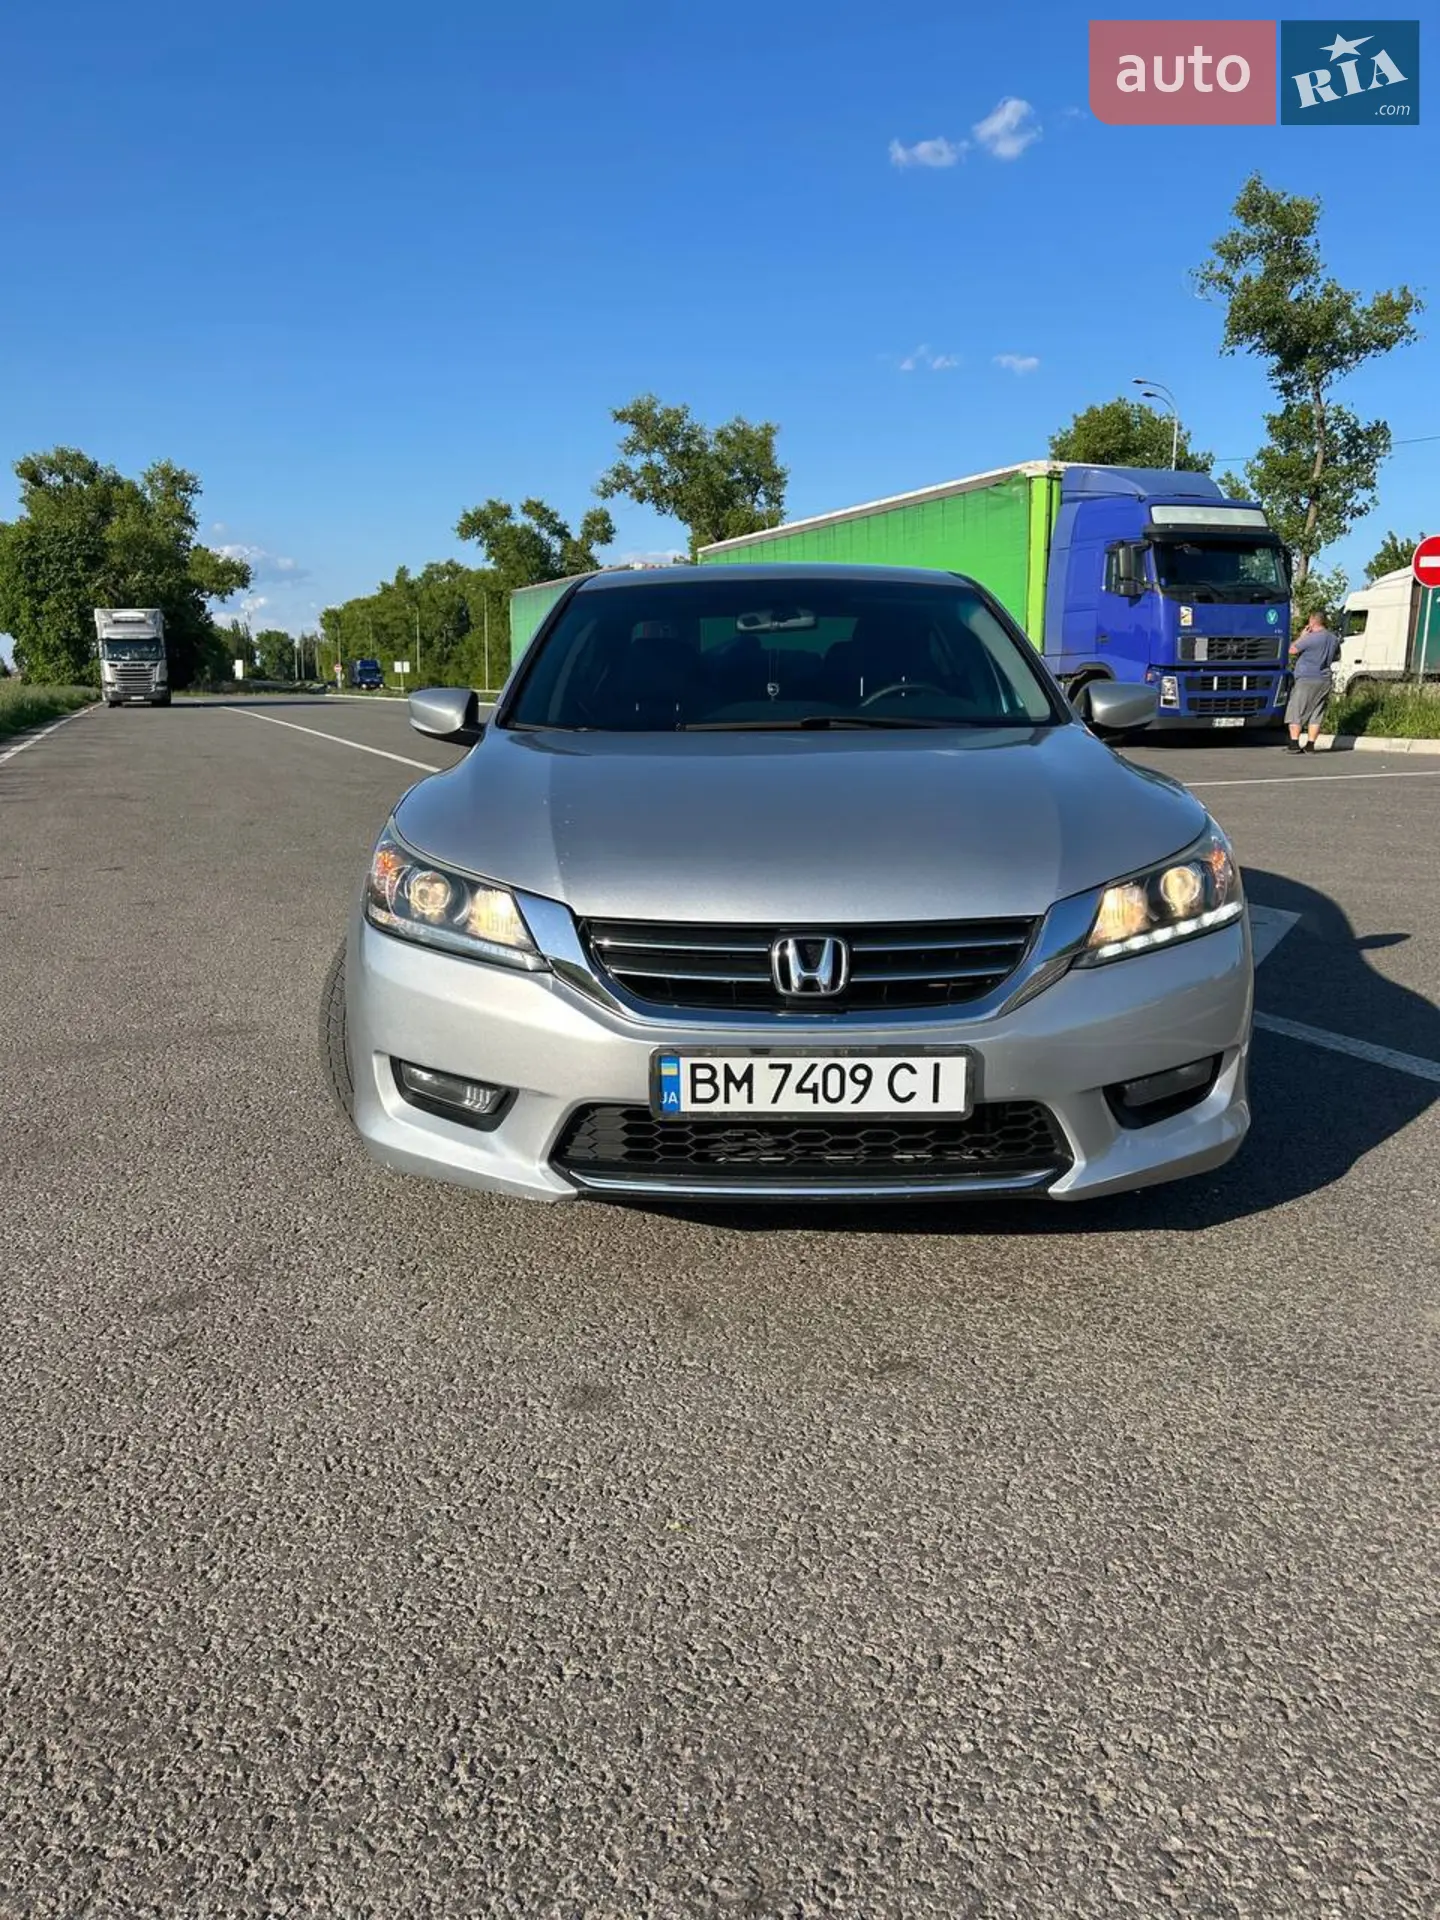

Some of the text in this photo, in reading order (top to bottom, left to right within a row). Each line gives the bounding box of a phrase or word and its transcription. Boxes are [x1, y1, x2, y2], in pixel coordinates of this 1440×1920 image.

[689, 1062, 941, 1105] BM 7409 CI
